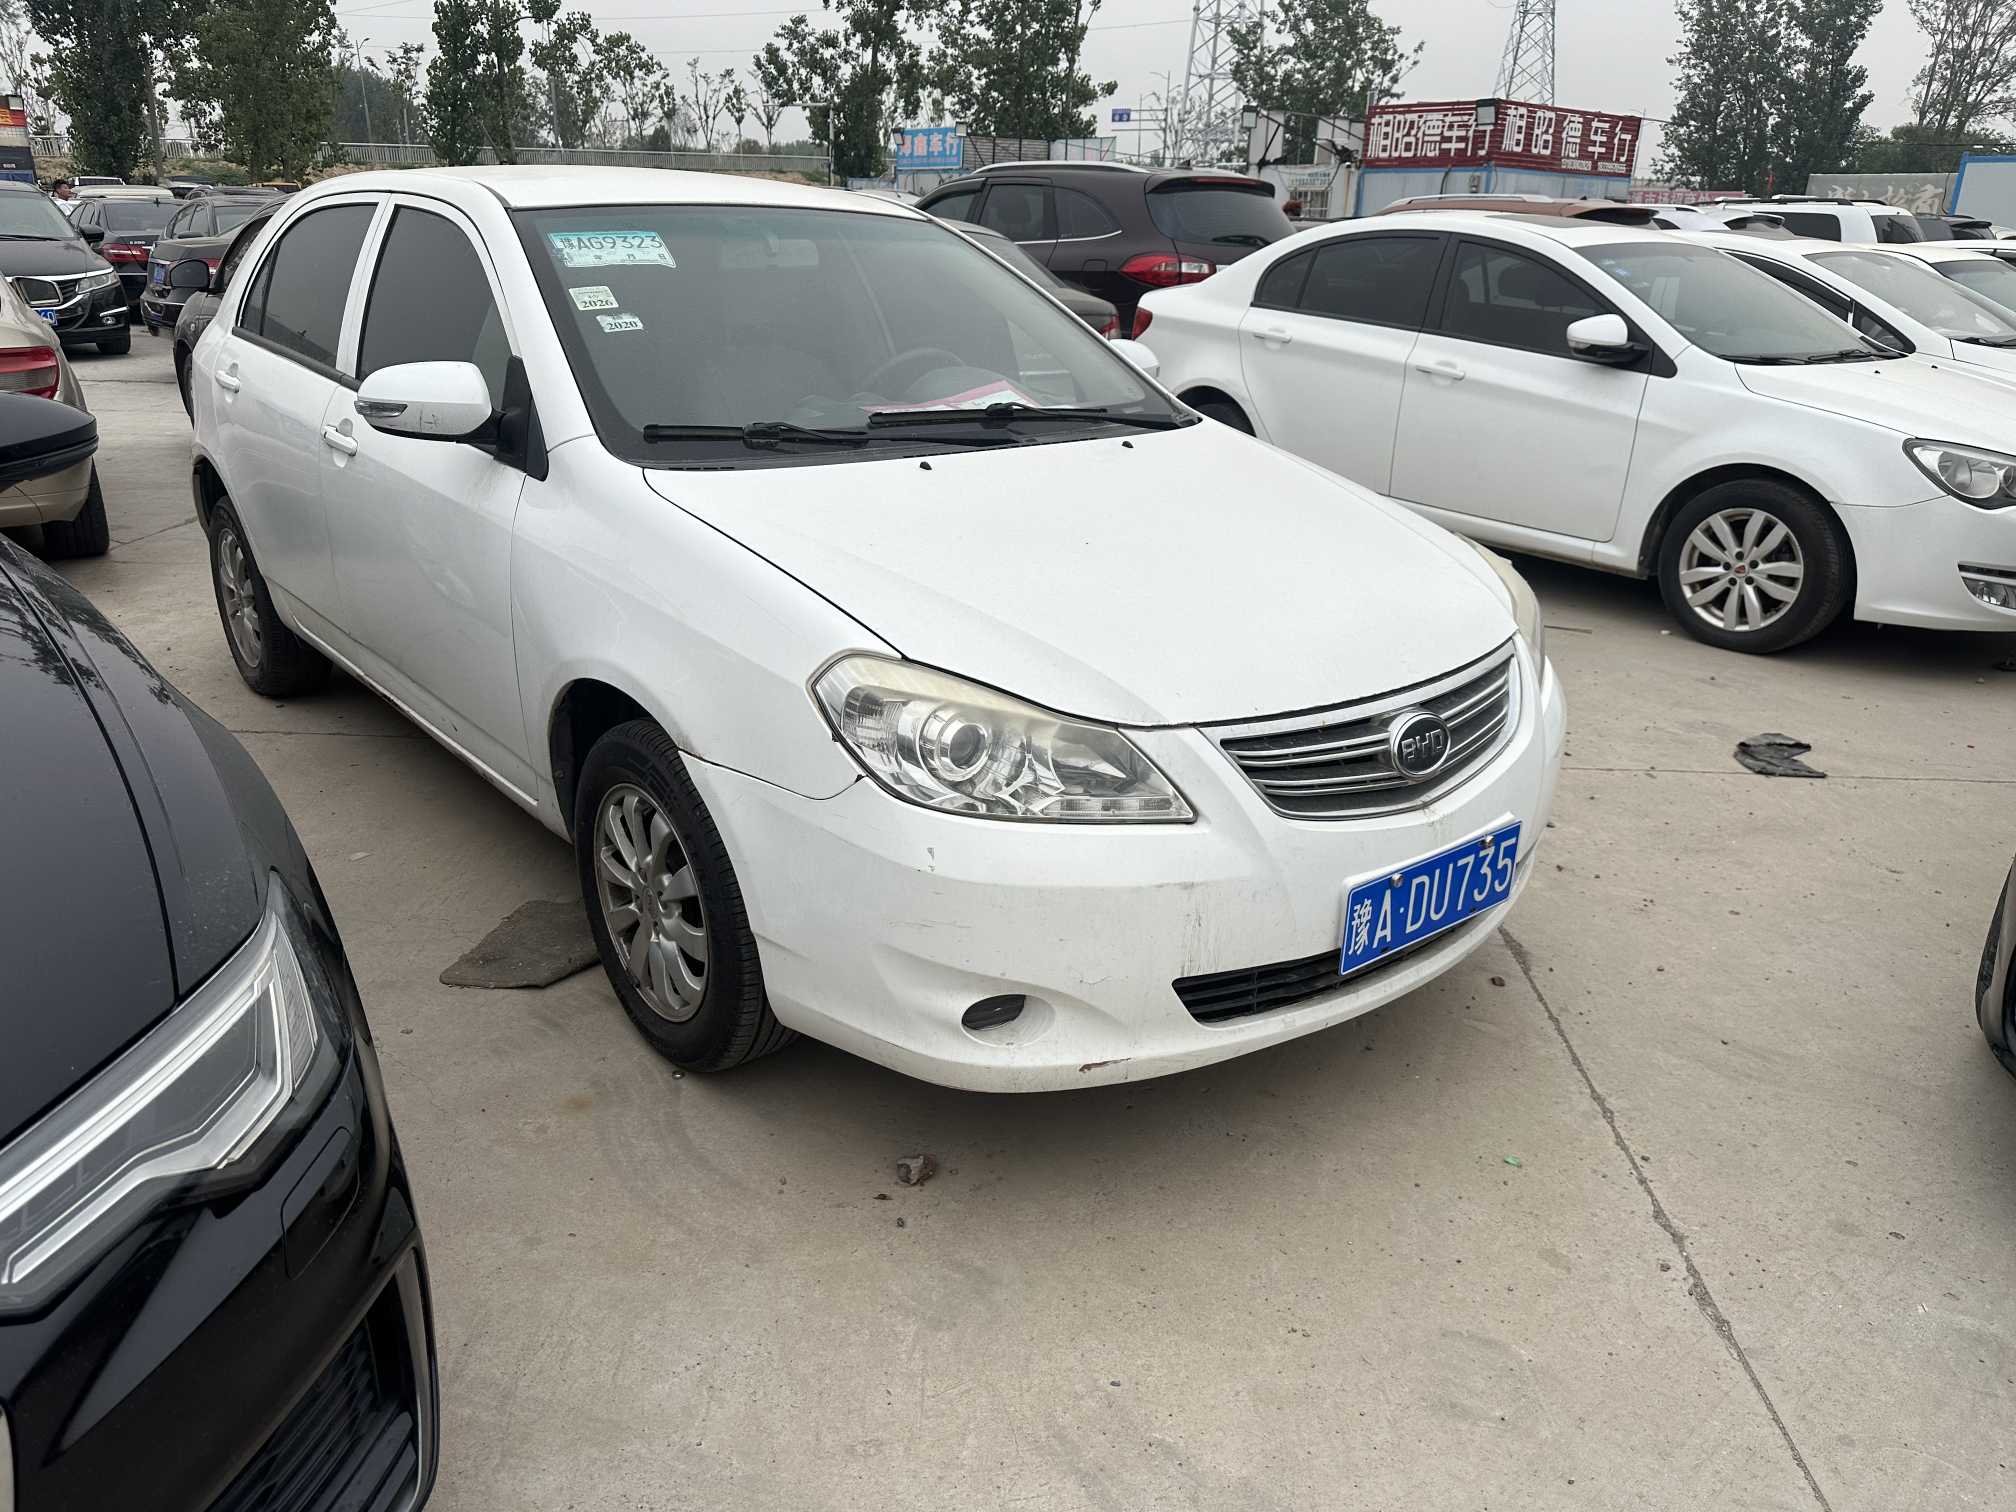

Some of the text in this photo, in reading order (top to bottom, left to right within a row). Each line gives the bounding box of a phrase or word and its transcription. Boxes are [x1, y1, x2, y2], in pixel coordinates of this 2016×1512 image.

[581, 299, 614, 309] 2026
[607, 320, 639, 331] 2020
[1401, 728, 1443, 762] BYD
[1348, 837, 1517, 956] 豫A·DU735
